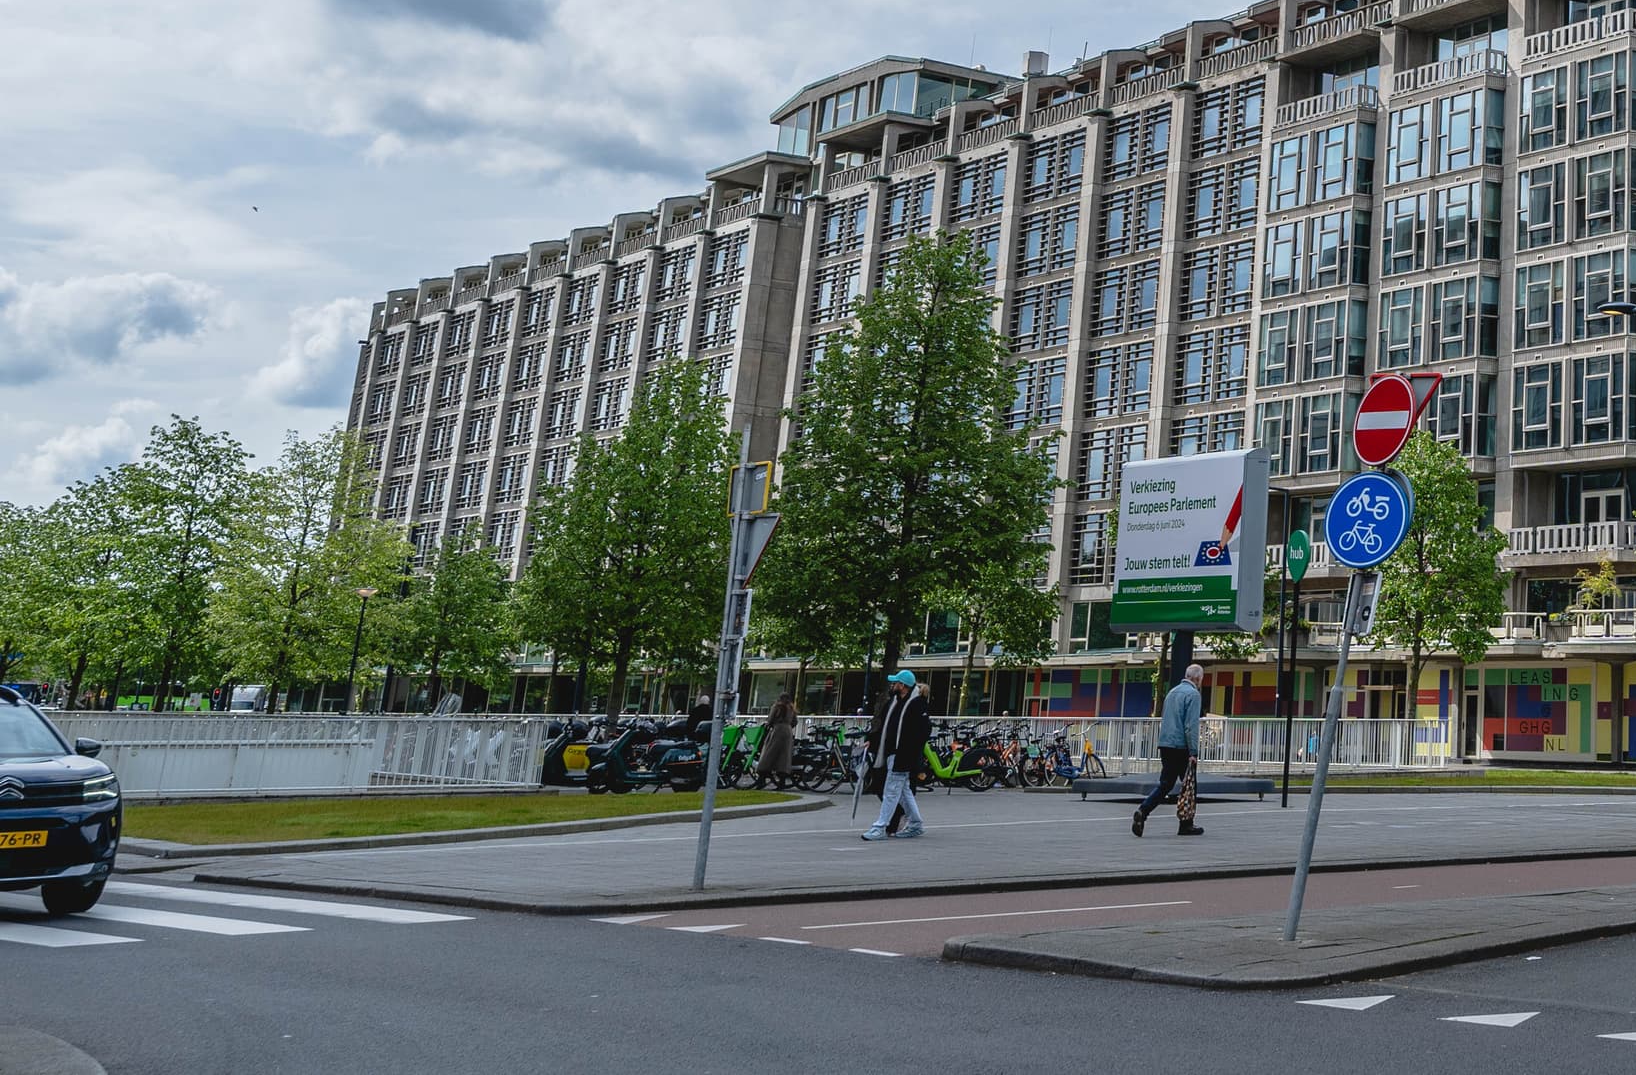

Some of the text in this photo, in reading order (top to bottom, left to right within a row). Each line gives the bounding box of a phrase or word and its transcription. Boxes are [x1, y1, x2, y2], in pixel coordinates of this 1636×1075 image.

[1130, 478, 1176, 494] Verkiezing
[1128, 495, 1216, 516] Europees Parlement
[1290, 545, 1304, 560] hub
[1124, 554, 1191, 571] Jouw stem telt!
[1510, 671, 1551, 684] LEAS
[1544, 687, 1579, 701] ING
[1519, 720, 1551, 735] GHG
[1545, 738, 1566, 752] NL
[0, 833, 42, 846] 76-PR
